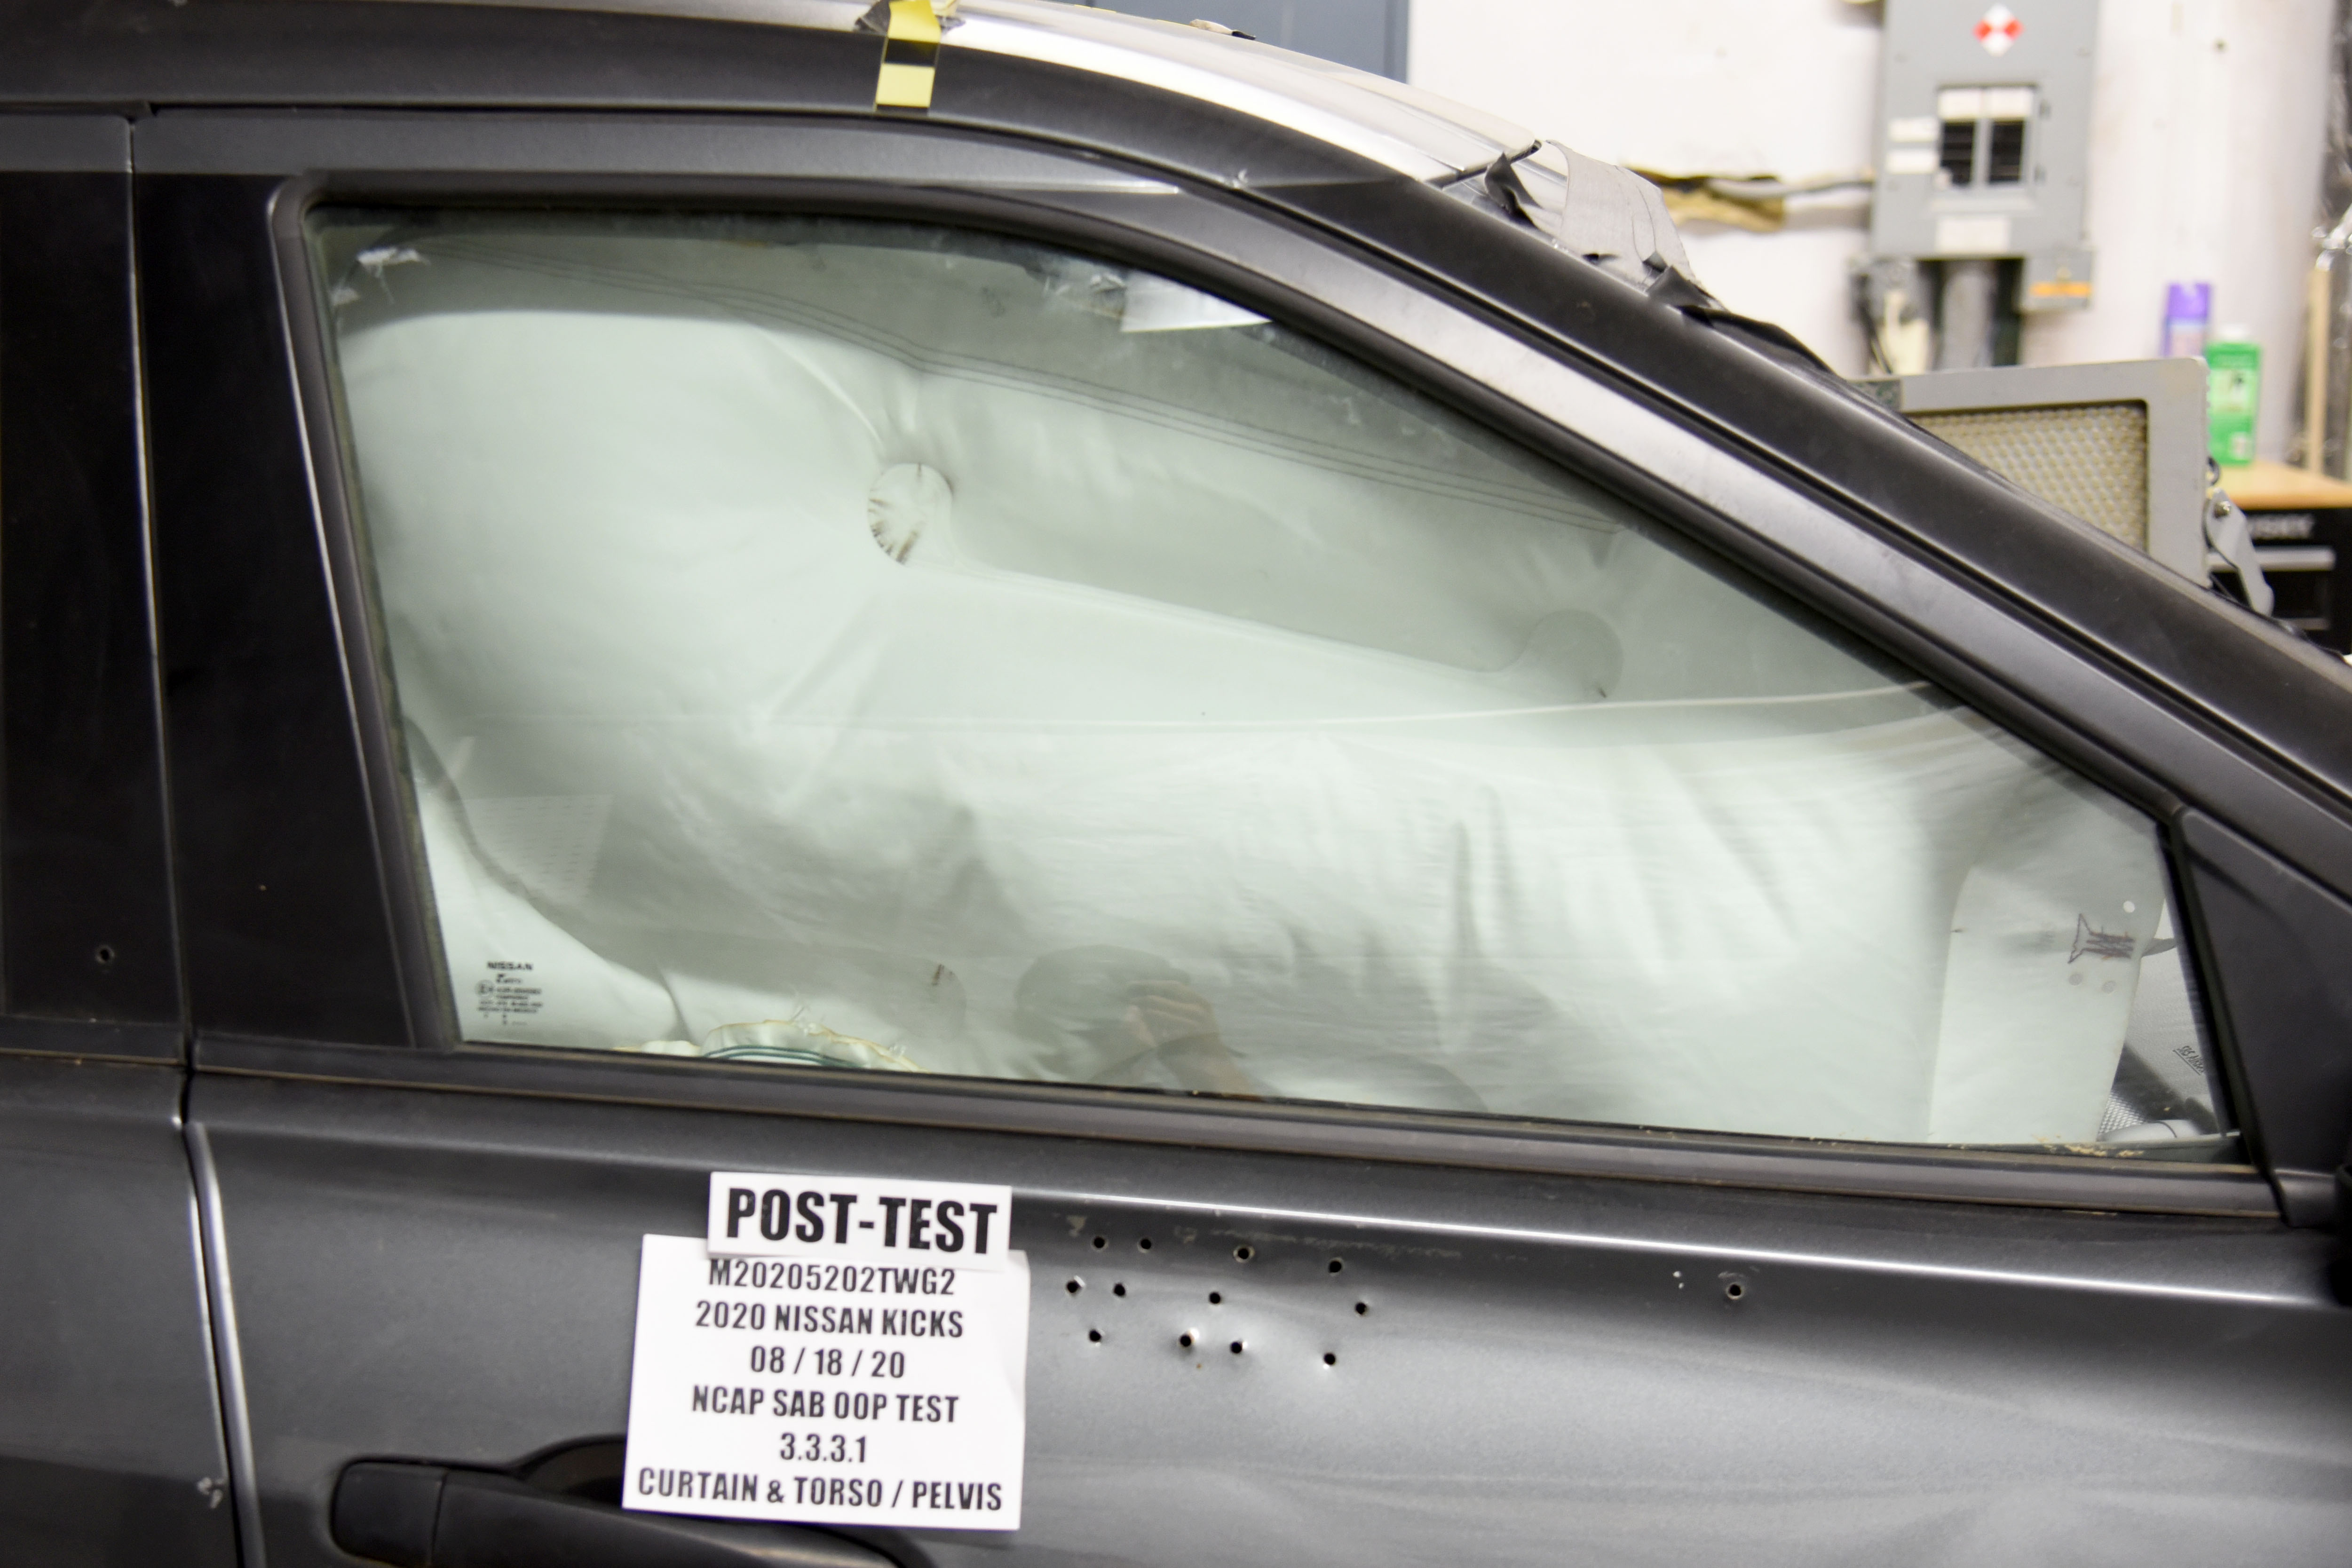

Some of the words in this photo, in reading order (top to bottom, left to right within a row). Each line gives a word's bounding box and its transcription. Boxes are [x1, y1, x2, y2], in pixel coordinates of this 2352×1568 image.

[727, 1188, 998, 1254] POST-TEST
[708, 1258, 955, 1295] M20205202TWG2
[696, 1301, 766, 1330] 2020
[775, 1304, 873, 1335] NISSAN
[882, 1309, 963, 1338] KICKS
[750, 1346, 785, 1373] 08
[815, 1348, 843, 1376] 18
[871, 1350, 905, 1378] 20
[692, 1386, 764, 1415] NCAP
[773, 1389, 824, 1418] SAB
[896, 1394, 959, 1423] TEST
[780, 1433, 866, 1463] 3.3.3.1
[639, 1467, 758, 1502] CURTAIN
[767, 1480, 784, 1503] &
[794, 1477, 883, 1507] TORSO
[912, 1481, 1002, 1511] PELVIS
